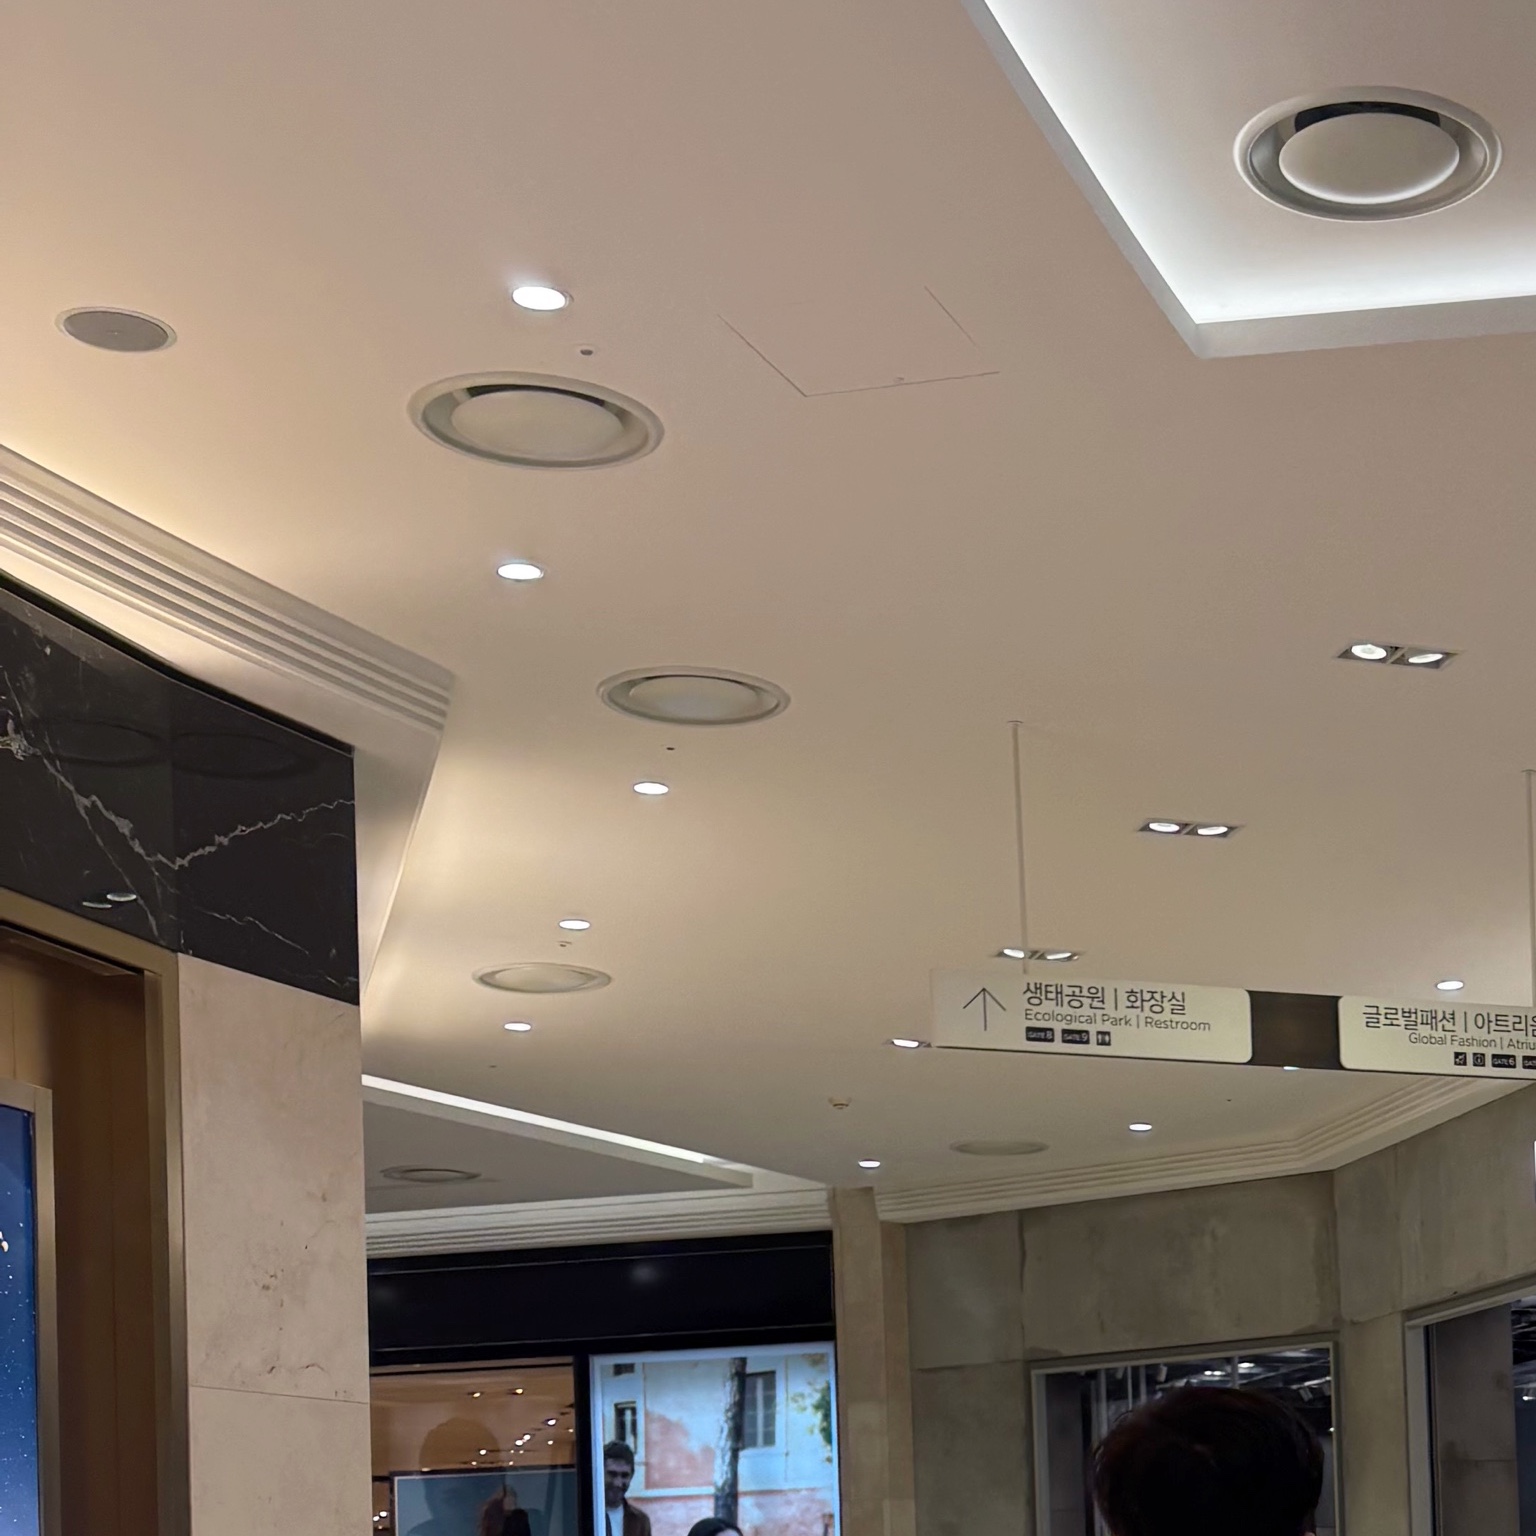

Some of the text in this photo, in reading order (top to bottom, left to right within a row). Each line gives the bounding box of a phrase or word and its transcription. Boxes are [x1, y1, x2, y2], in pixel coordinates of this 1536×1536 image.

[1023, 982, 1187, 1016] 생태공원 화장실
[1024, 1008, 1211, 1032] Ecological Park Restroom
[1362, 1004, 1457, 1033] 글로벌패션
[1408, 1032, 1447, 1046] Global
[1450, 1034, 1497, 1049] Fashion
